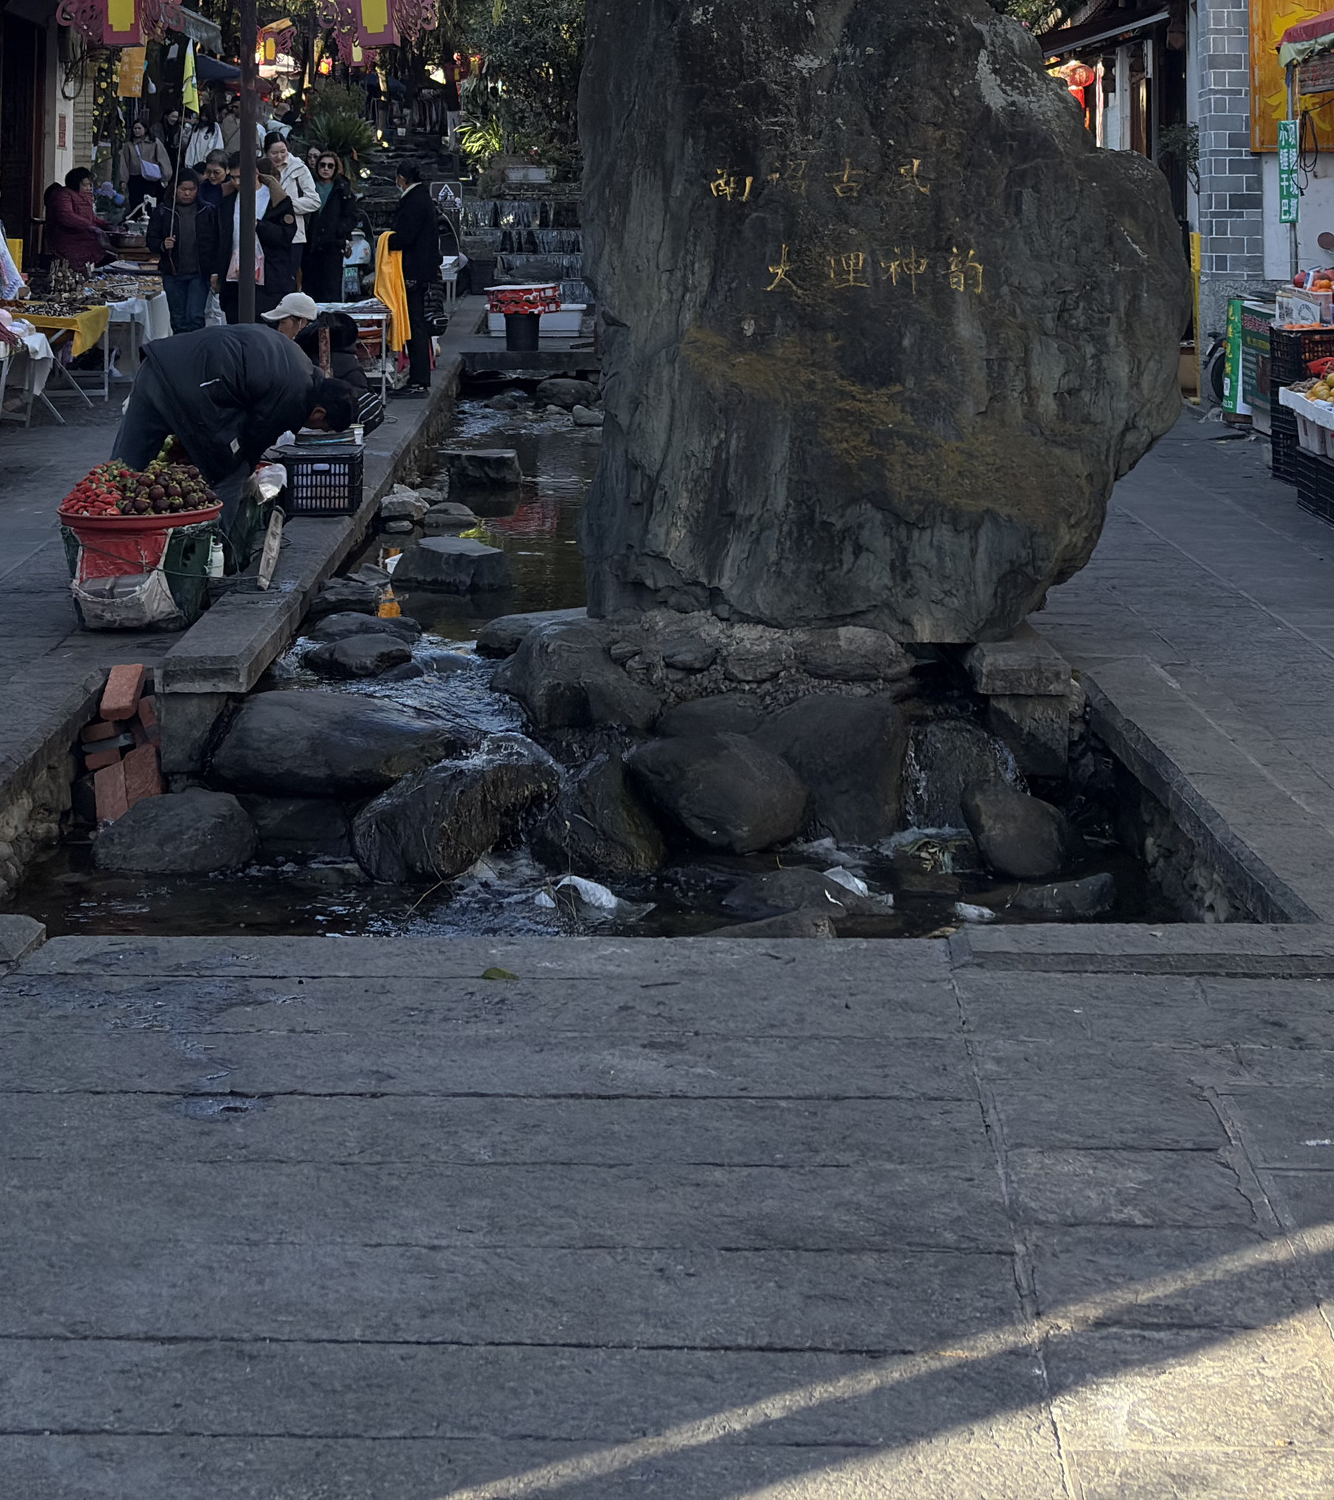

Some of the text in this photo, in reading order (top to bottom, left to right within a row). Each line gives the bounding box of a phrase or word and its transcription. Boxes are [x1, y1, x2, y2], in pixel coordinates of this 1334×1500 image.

[710, 157, 932, 203] 南诏古风
[763, 244, 985, 296] 大理神韵
